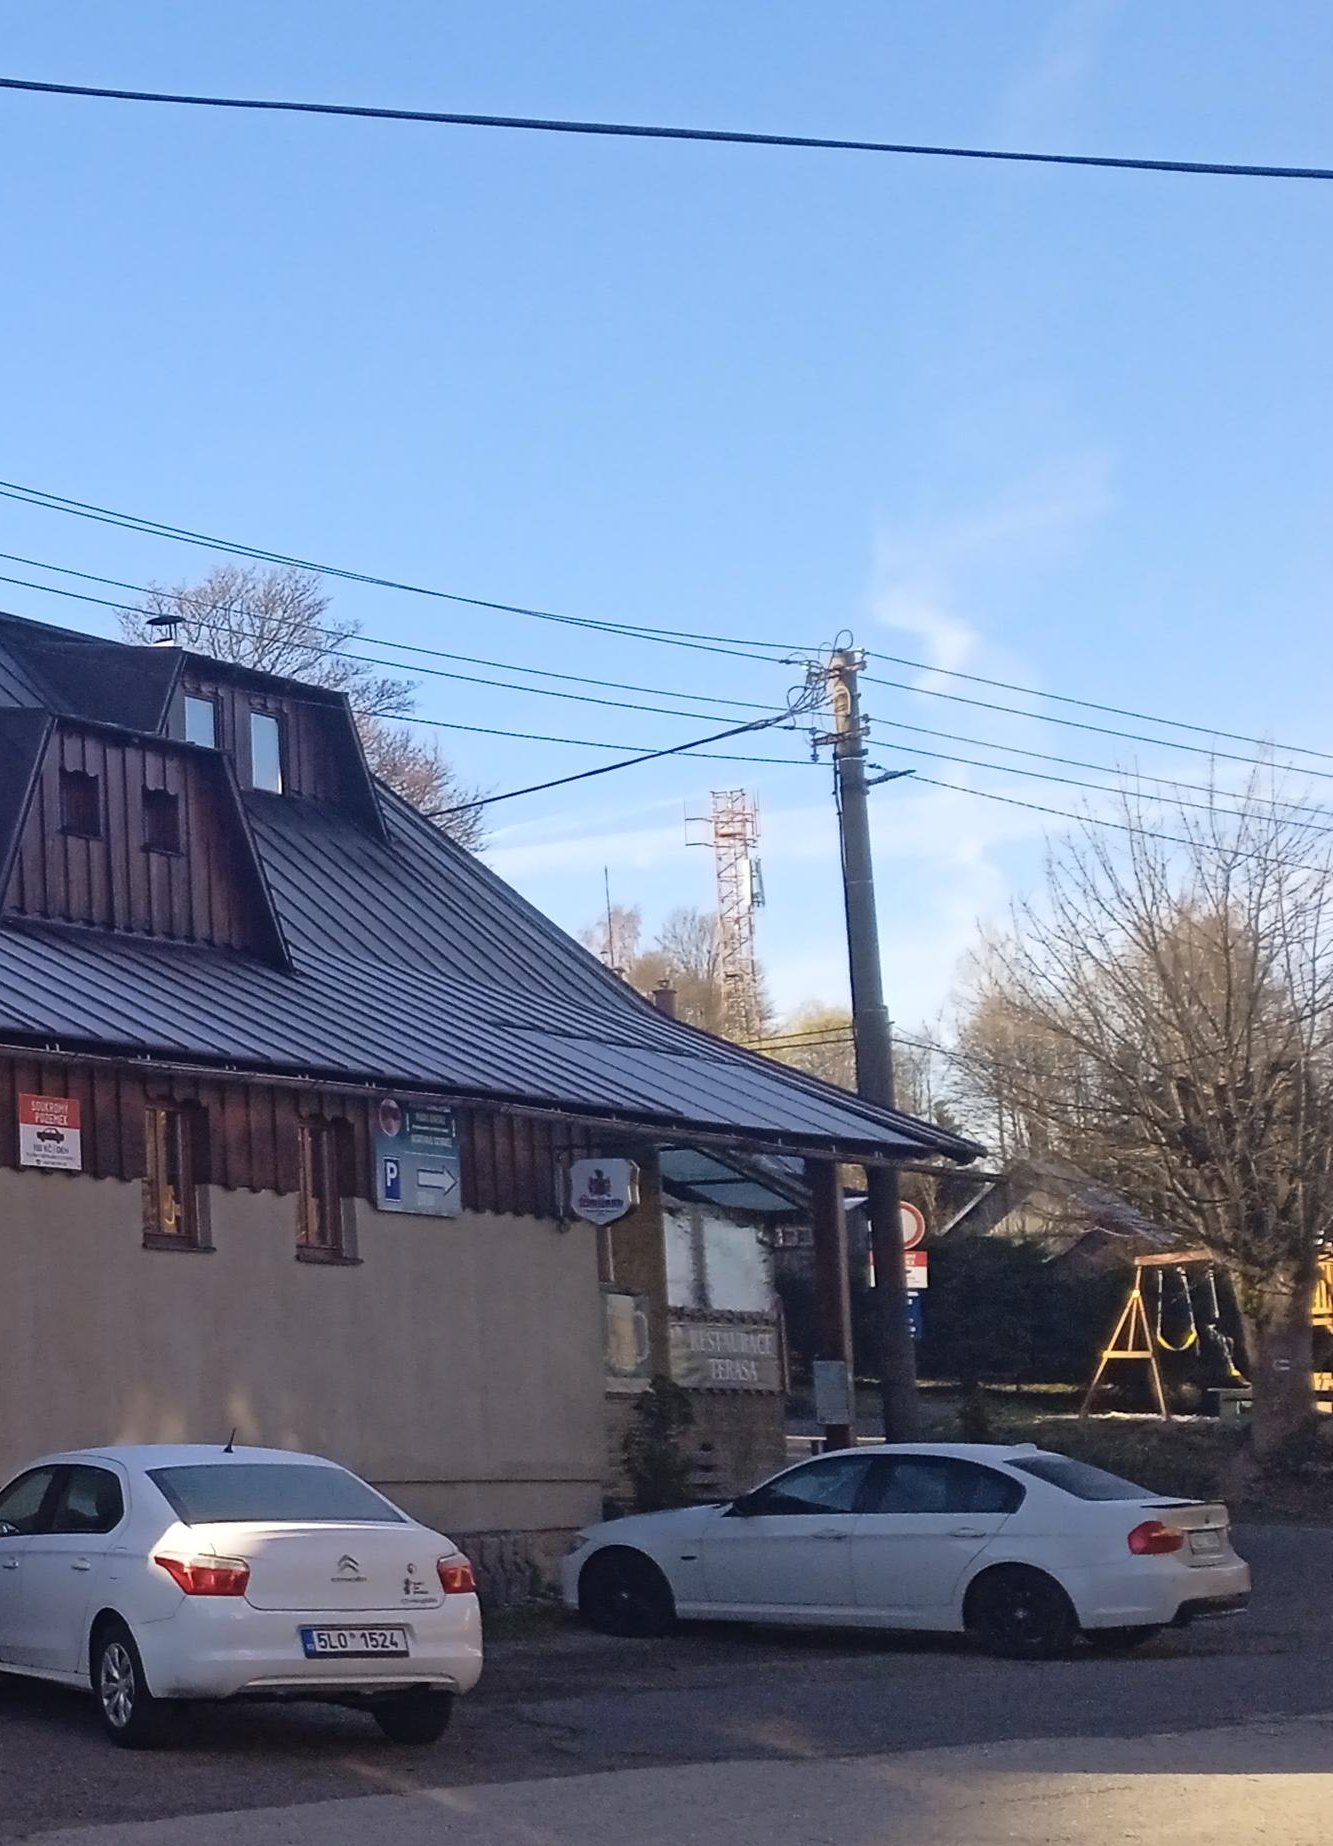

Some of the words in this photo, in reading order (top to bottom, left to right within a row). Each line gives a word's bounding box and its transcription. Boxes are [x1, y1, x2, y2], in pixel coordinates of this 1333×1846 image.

[35, 1112, 69, 1126] POZEMEK
[386, 1161, 398, 1187] P
[690, 1330, 773, 1355] RESTAURACE
[709, 1358, 758, 1382] TERASA
[317, 1632, 348, 1649] 5L0
[360, 1631, 399, 1649] 1524
